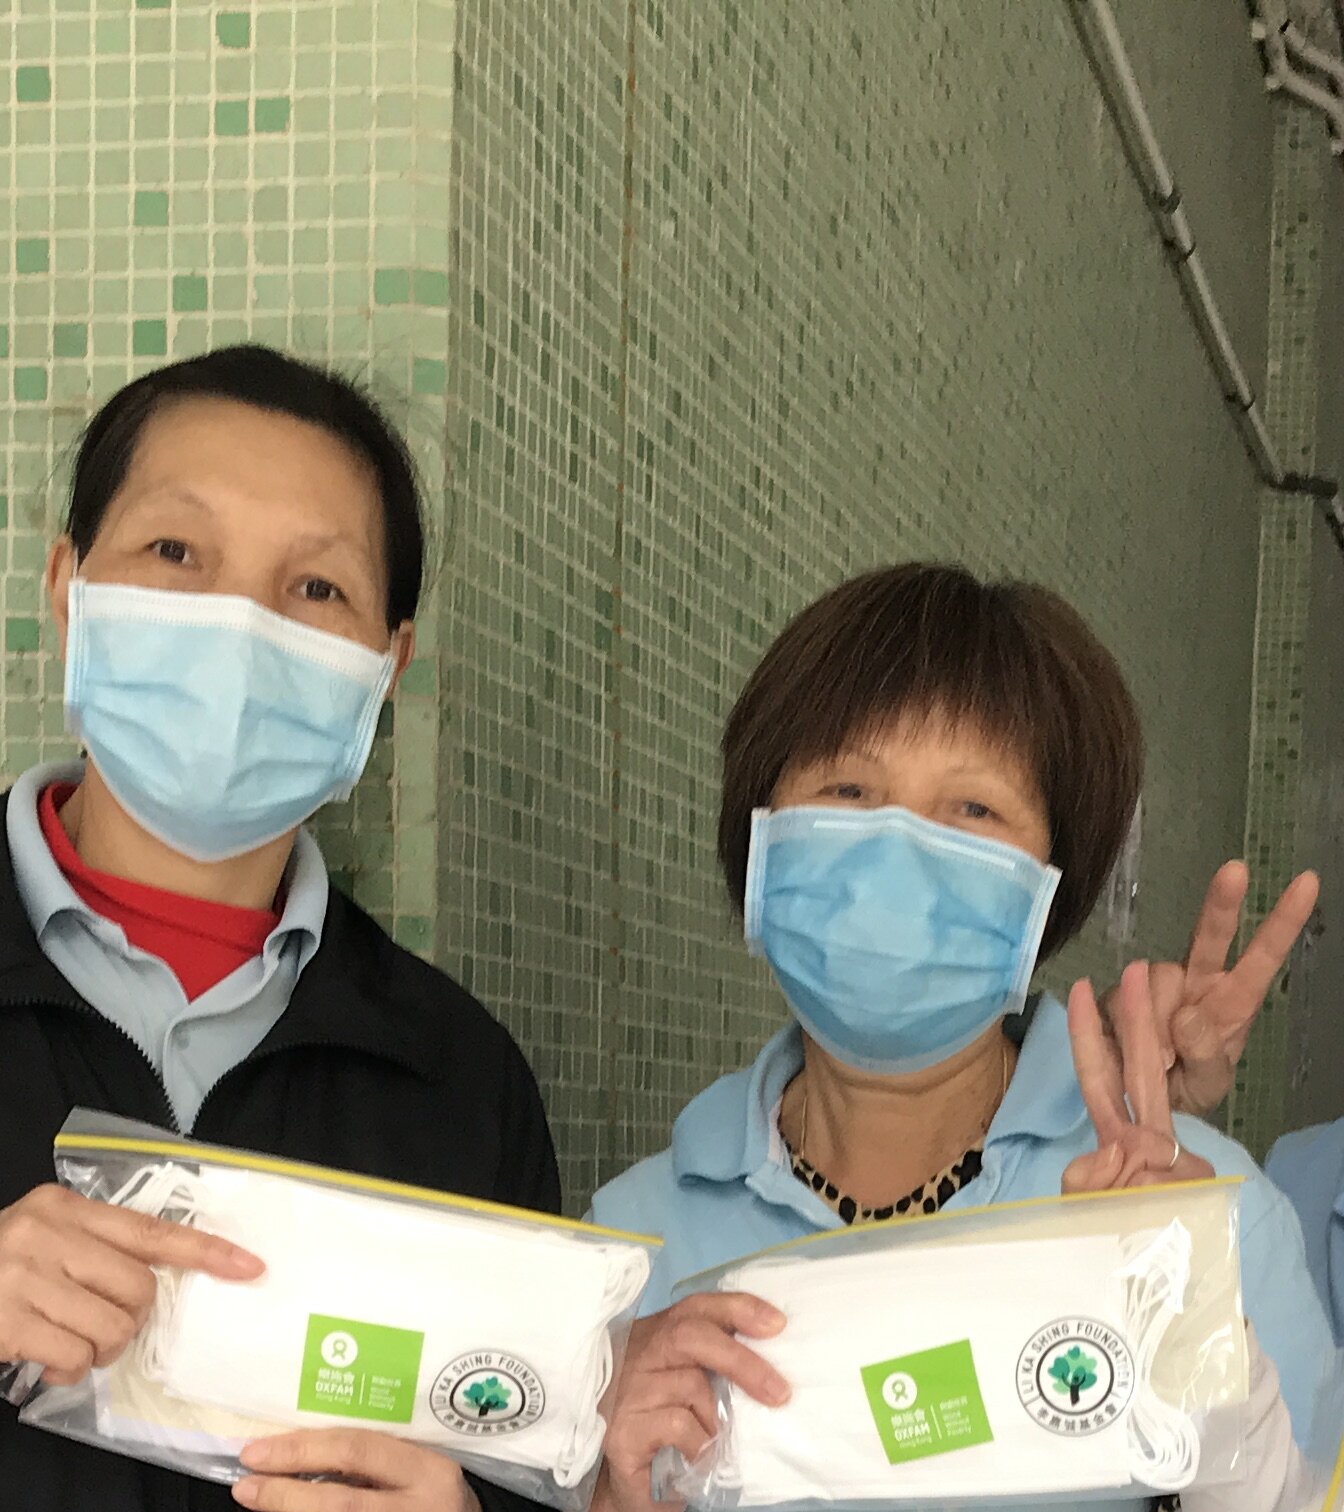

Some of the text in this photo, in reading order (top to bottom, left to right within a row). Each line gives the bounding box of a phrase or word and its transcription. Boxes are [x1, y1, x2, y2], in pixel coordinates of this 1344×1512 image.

[1021, 1357, 1034, 1374] KA
[1031, 1322, 1070, 1354] SHING
[315, 1380, 354, 1397] OXFAM
[452, 1354, 492, 1376] SHING
[498, 1356, 540, 1417] FOUNDATION
[894, 1421, 931, 1442] OXFAM
